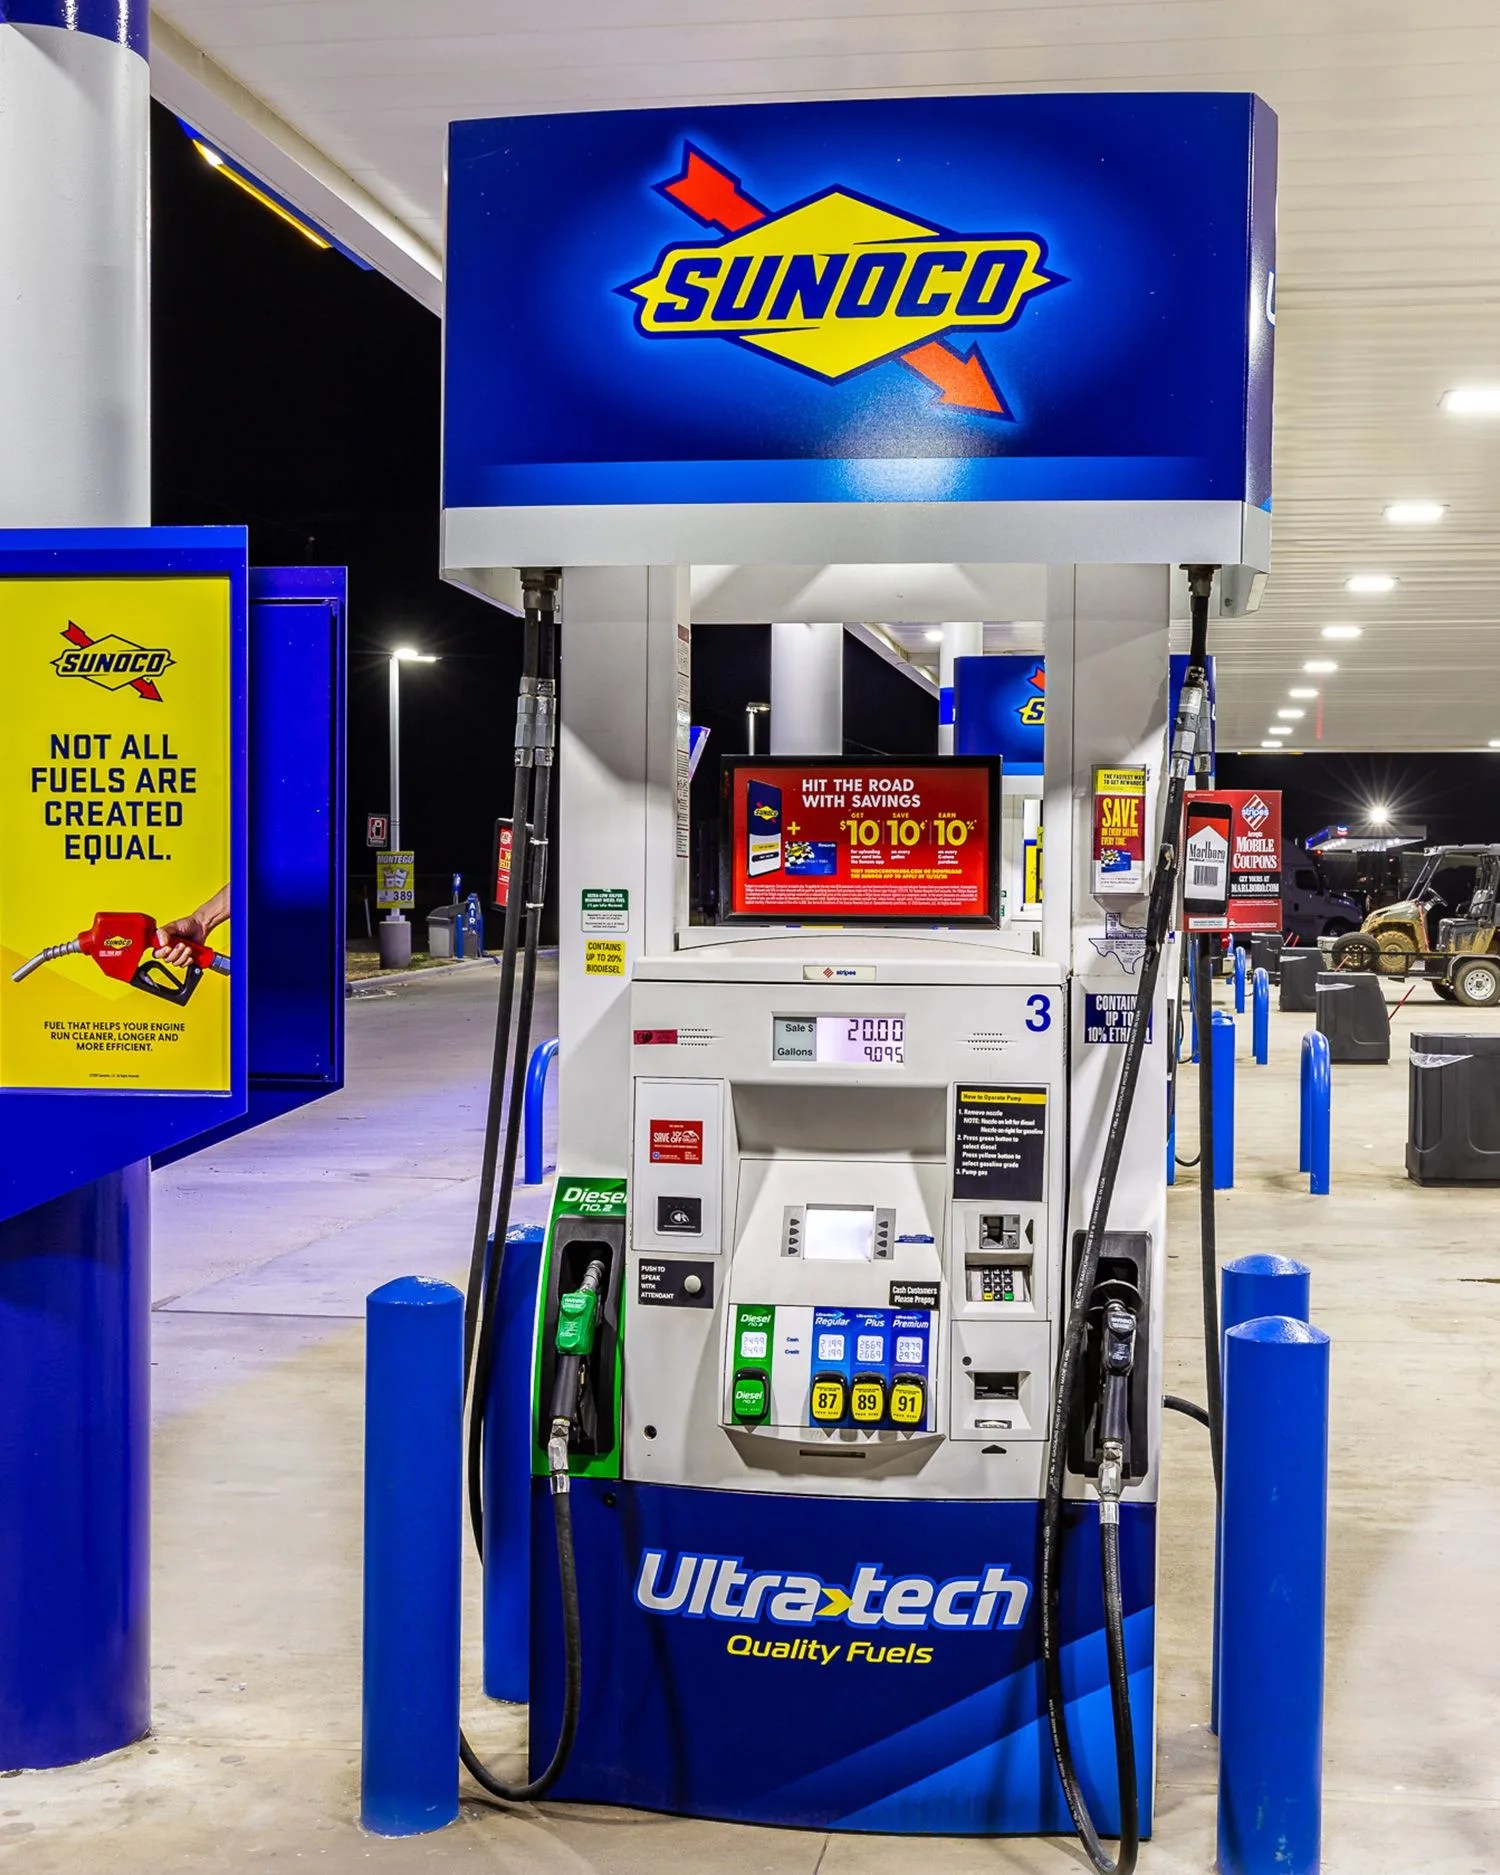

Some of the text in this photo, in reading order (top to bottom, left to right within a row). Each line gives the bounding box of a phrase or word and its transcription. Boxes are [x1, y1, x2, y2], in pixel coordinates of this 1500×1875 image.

[652, 249, 1030, 324] SUNOCO
[61, 653, 165, 672] SUNOCO
[50, 734, 178, 759] NOT ALL
[32, 768, 196, 793] FUELS ARE
[802, 779, 914, 792] HIT THE ROAD
[802, 795, 920, 808] WITH SAVINGS
[45, 801, 183, 827] CREATED
[1102, 798, 1139, 828] SAVE
[1242, 807, 1269, 817] stripes
[65, 834, 171, 865] EQUAL.
[1189, 841, 1226, 860] Marlboro
[1236, 837, 1274, 853] MOBILE
[1233, 853, 1277, 869] COUPONS
[1231, 884, 1279, 893] MARLBORO.COM
[393, 891, 412, 900] 389
[588, 942, 621, 951] CONTAINS
[586, 953, 622, 962] UP TO 20%
[586, 964, 620, 973] BIODIESEL
[1096, 995, 1138, 1010] CONTAIN
[1025, 994, 1052, 1032] 3
[1106, 1011, 1134, 1026] UP TO
[44, 1022, 185, 1031] FUEL THAT HELPS YOUR ENGINE
[785, 1024, 814, 1033] Sale $
[848, 1019, 903, 1041] 20.00
[51, 1032, 179, 1042] RUN CLEANER, LONGER AND
[1088, 1027, 1151, 1042] 10% ETHL
[76, 1043, 153, 1052] MORE EFFICIENT.
[777, 1048, 813, 1056] Gallons
[864, 1047, 904, 1063] 9.095
[654, 1132, 670, 1143] SAVE
[892, 1286, 906, 1294] Cash
[915, 1296, 935, 1305] Prepay
[741, 1314, 772, 1323] Diesel
[815, 1317, 850, 1327] Regular
[865, 1319, 885, 1327] Plus
[893, 1320, 929, 1328] Premium
[736, 1391, 763, 1399] Diesel
[818, 1393, 837, 1408] 87
[858, 1394, 877, 1410] 89
[898, 1396, 916, 1413] 91
[726, 1634, 934, 1665] Quality Fuels
